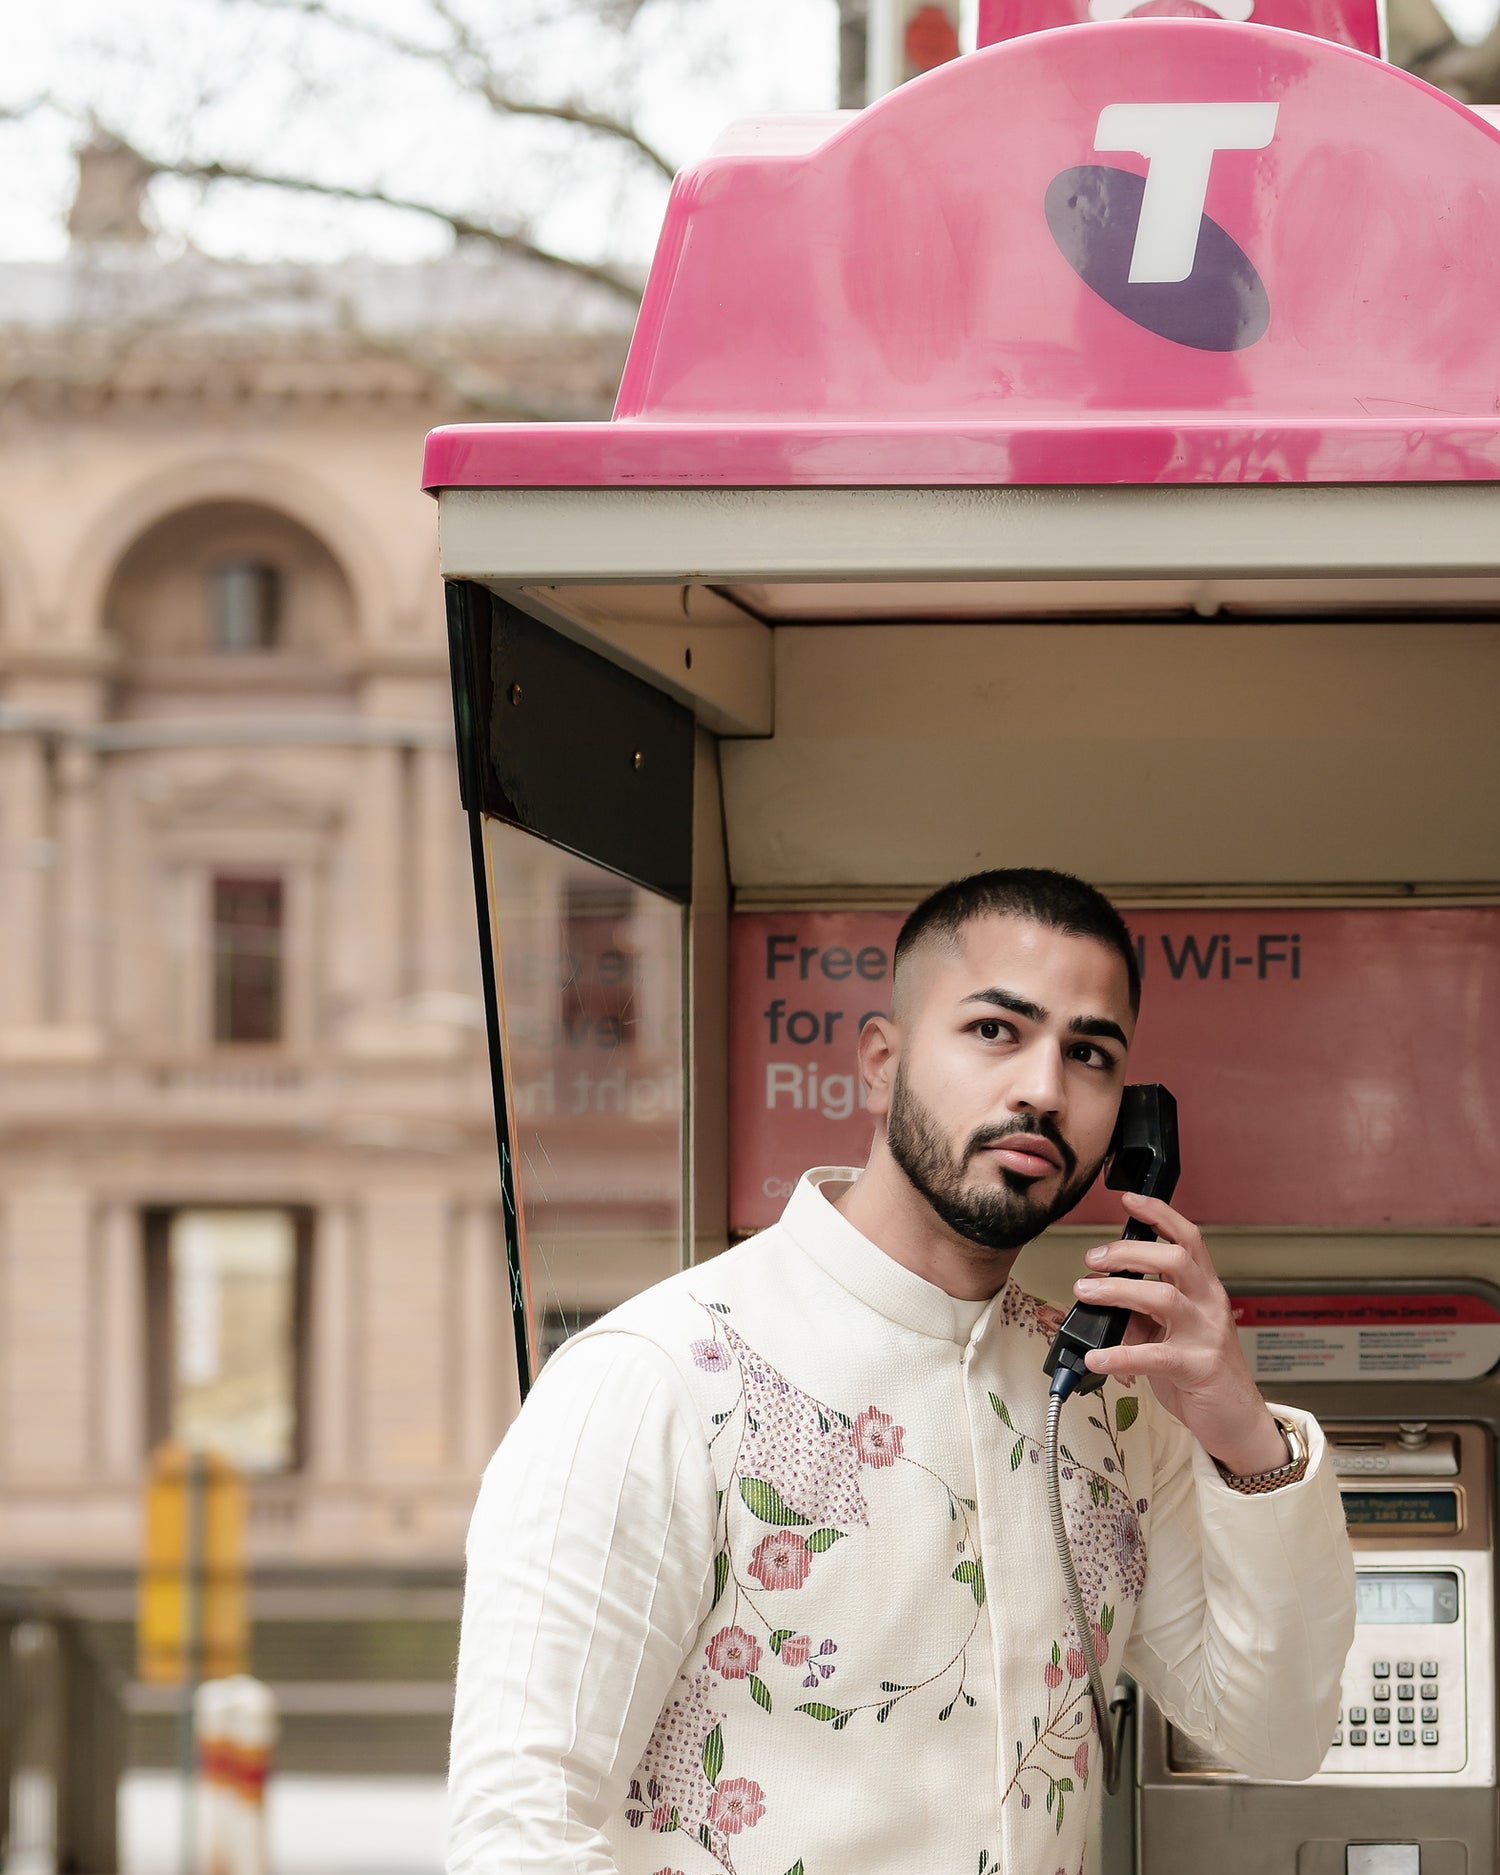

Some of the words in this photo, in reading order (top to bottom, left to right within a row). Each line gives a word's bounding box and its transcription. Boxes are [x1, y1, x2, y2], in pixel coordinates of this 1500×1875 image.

[1093, 102, 1280, 284] T
[766, 934, 888, 981] Free
[1161, 934, 1301, 981] Wi-Fi
[764, 1000, 844, 1045] for
